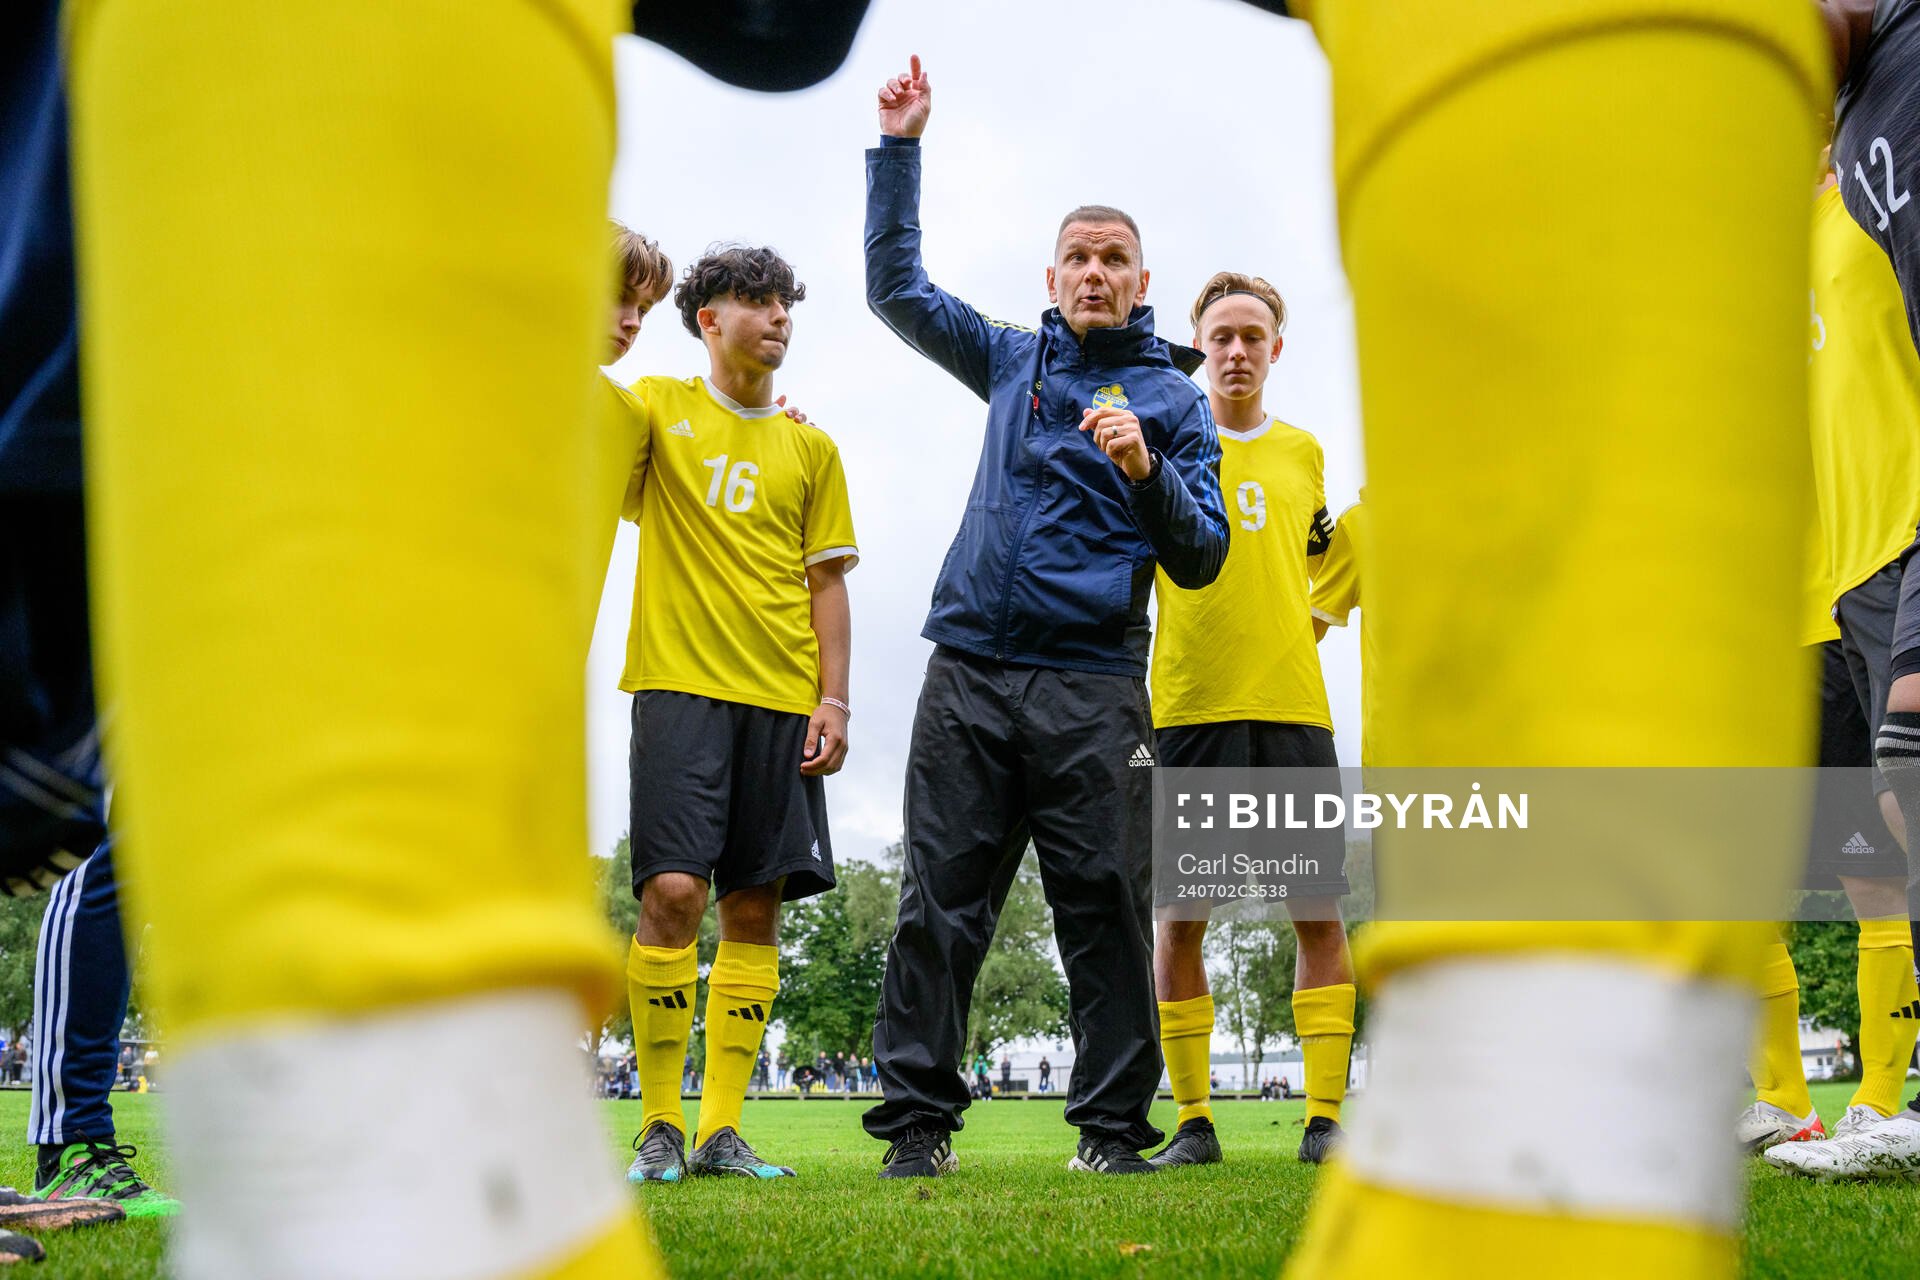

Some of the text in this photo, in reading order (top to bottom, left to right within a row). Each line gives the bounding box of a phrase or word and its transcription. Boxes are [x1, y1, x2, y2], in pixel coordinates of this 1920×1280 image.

[1855, 136, 1910, 231] 12
[703, 454, 760, 513] 16
[1237, 481, 1266, 532] 9
[1841, 846, 1875, 854] adidas
